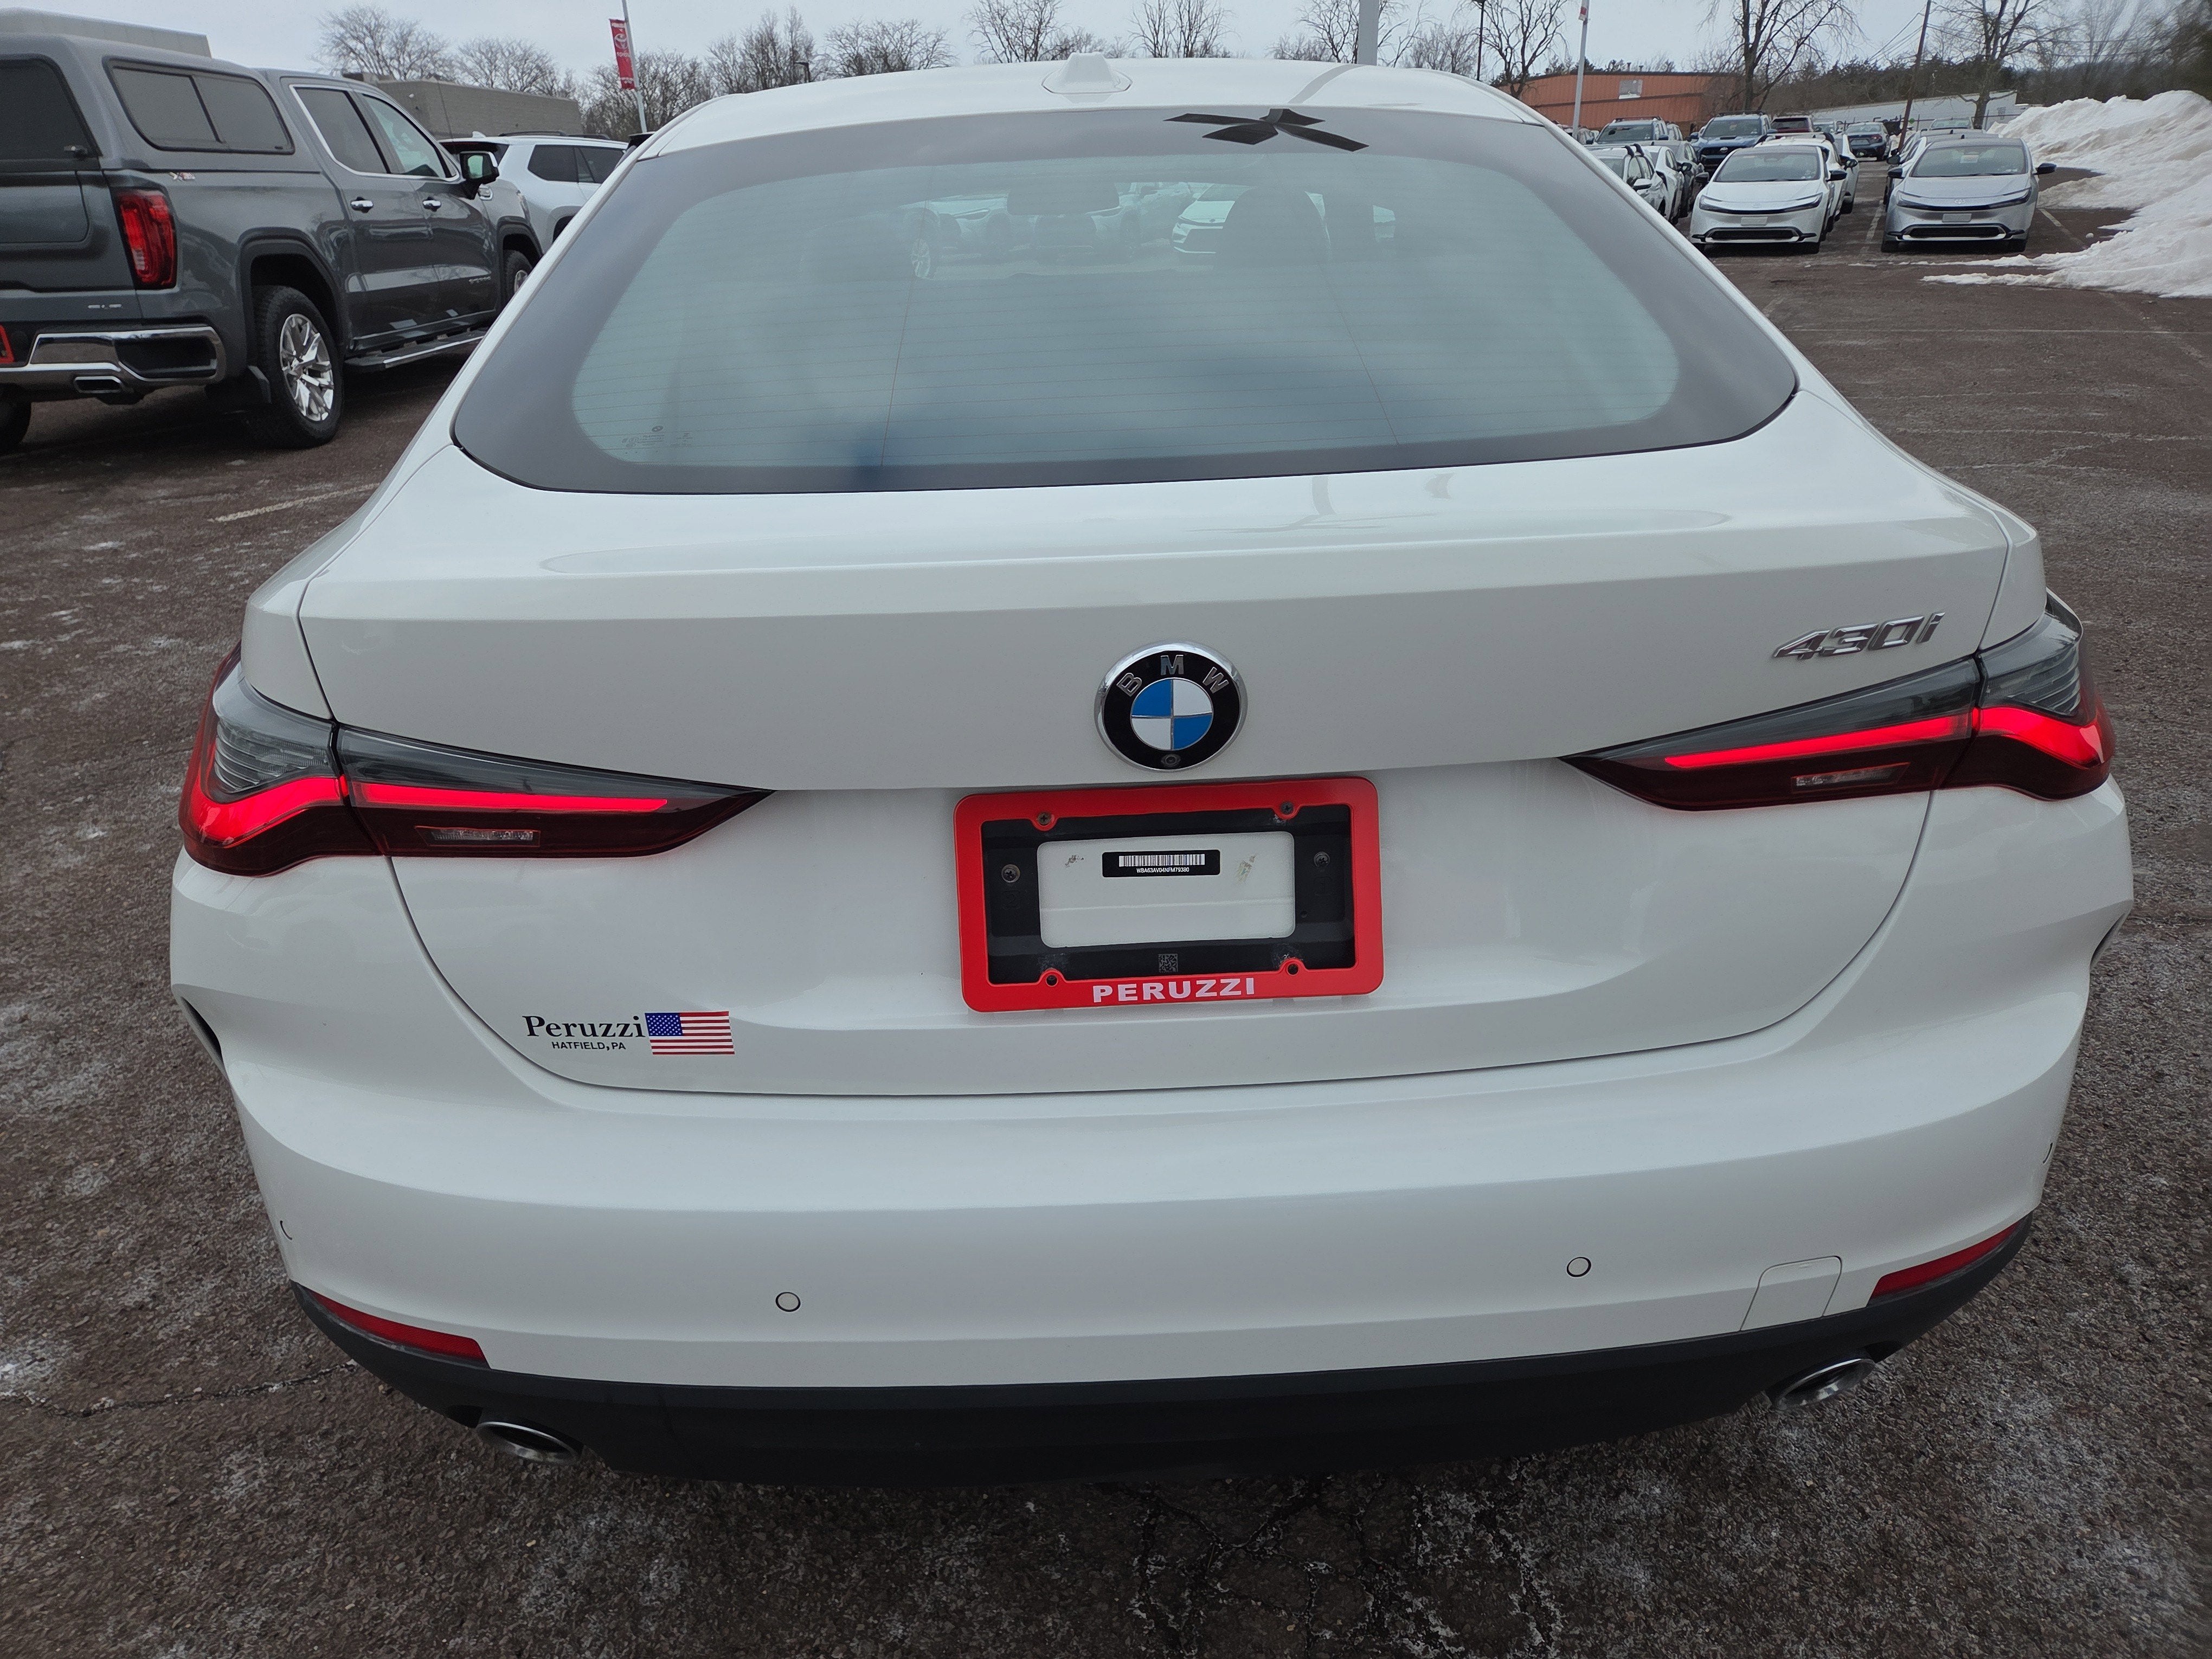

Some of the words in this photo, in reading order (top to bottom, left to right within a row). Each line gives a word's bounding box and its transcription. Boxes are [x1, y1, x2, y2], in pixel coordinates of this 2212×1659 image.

[1773, 612, 1946, 660] 430i
[1116, 654, 1229, 697] BMW
[1092, 978, 1255, 1003] PERUZZI
[522, 1015, 646, 1038] Peruzzi
